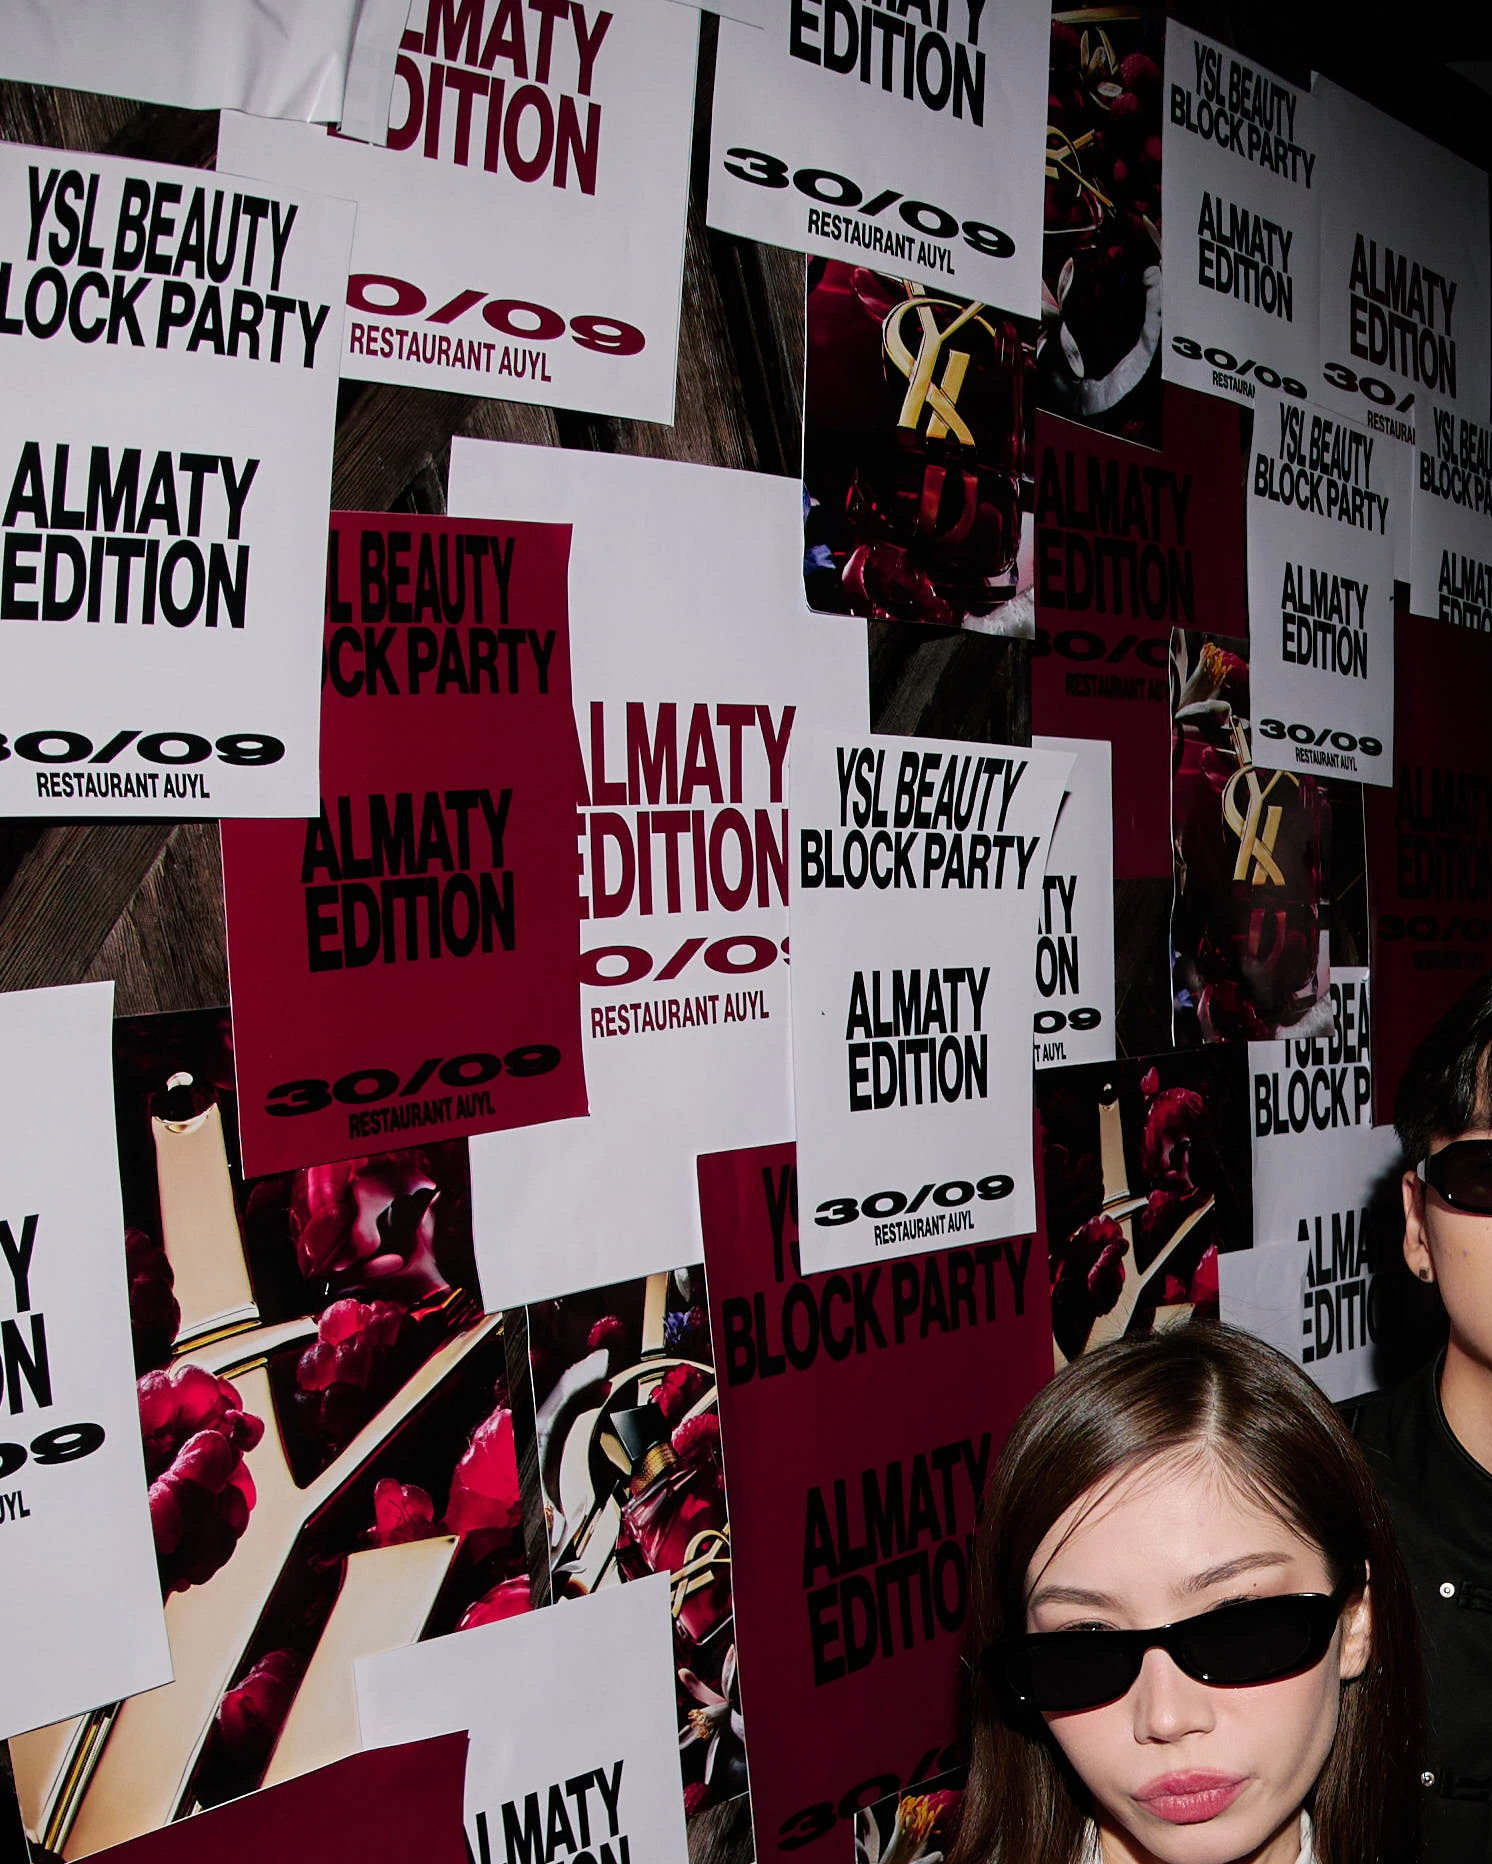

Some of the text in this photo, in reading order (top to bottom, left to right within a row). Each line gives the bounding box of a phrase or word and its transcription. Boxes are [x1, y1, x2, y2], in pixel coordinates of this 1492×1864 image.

[402, 0, 613, 96] MATY
[789, 0, 986, 128] EDITION
[387, 54, 602, 196] DITION
[1194, 40, 1298, 142] YSL BEAUTY
[1170, 83, 1316, 189] BLOCK PARTY
[27, 165, 299, 291] YSL BEAUTY
[723, 147, 1016, 259] 30/09
[807, 208, 955, 275] RESTAURANT AUYL
[1197, 191, 1293, 274] ALMATY
[0, 262, 331, 369] LOCK PARTY
[346, 273, 646, 356] 0/09
[1198, 238, 1293, 323] EDITION
[1349, 232, 1458, 337] ALMATY
[350, 322, 552, 382] RESTAURANT AUYL
[1171, 335, 1308, 400] 30/09
[1212, 369, 1256, 400] RESTAURA
[1350, 294, 1457, 399] EDITION
[1323, 362, 1415, 414] 30/
[1367, 410, 1416, 446] RESTAURA
[1279, 402, 1374, 489] YSL BEAUTY
[1433, 406, 1458, 465] YSL
[2, 440, 260, 540] ALMATY
[1037, 446, 1194, 547] ALMATY
[1254, 452, 1389, 535] BLOCK PARTY
[1420, 451, 1472, 510] BLOCK
[0, 531, 251, 630] EDITION
[361, 530, 516, 625] BEAUTY
[1038, 528, 1194, 624] EDITION
[1281, 561, 1369, 630] ALMATY
[407, 627, 557, 695] PARTY
[1282, 611, 1368, 679] EDITION
[0, 730, 285, 766] 0/09
[1259, 718, 1383, 756] 30/09
[1295, 746, 1358, 772] RESTAURANT AUYL
[36, 772, 211, 799] RESTAURANT AUYL
[836, 747, 1028, 832] YSL BEAUTY
[302, 788, 513, 884] ALMATY
[801, 829, 1040, 889] BLOCK PARTY
[305, 870, 516, 973] EDITION
[580, 934, 791, 988] 0/0
[591, 990, 770, 1039] RESTAURANT AUYL
[846, 967, 991, 1040] ALMATY
[265, 1044, 562, 1117] 30/09
[848, 1034, 988, 1112] EDITION
[1042, 1042, 1067, 1063] AUYL
[349, 1089, 497, 1139] RESTAURANT AUYL
[1255, 1066, 1350, 1137] BLOCK
[814, 1174, 1015, 1227] 30/09
[874, 1210, 974, 1246] RESTAURANT AUYL
[723, 1238, 1032, 1387] BLOCK PARTY
[803, 1432, 992, 1588] ALMATY
[807, 1540, 975, 1687] EDITIO
